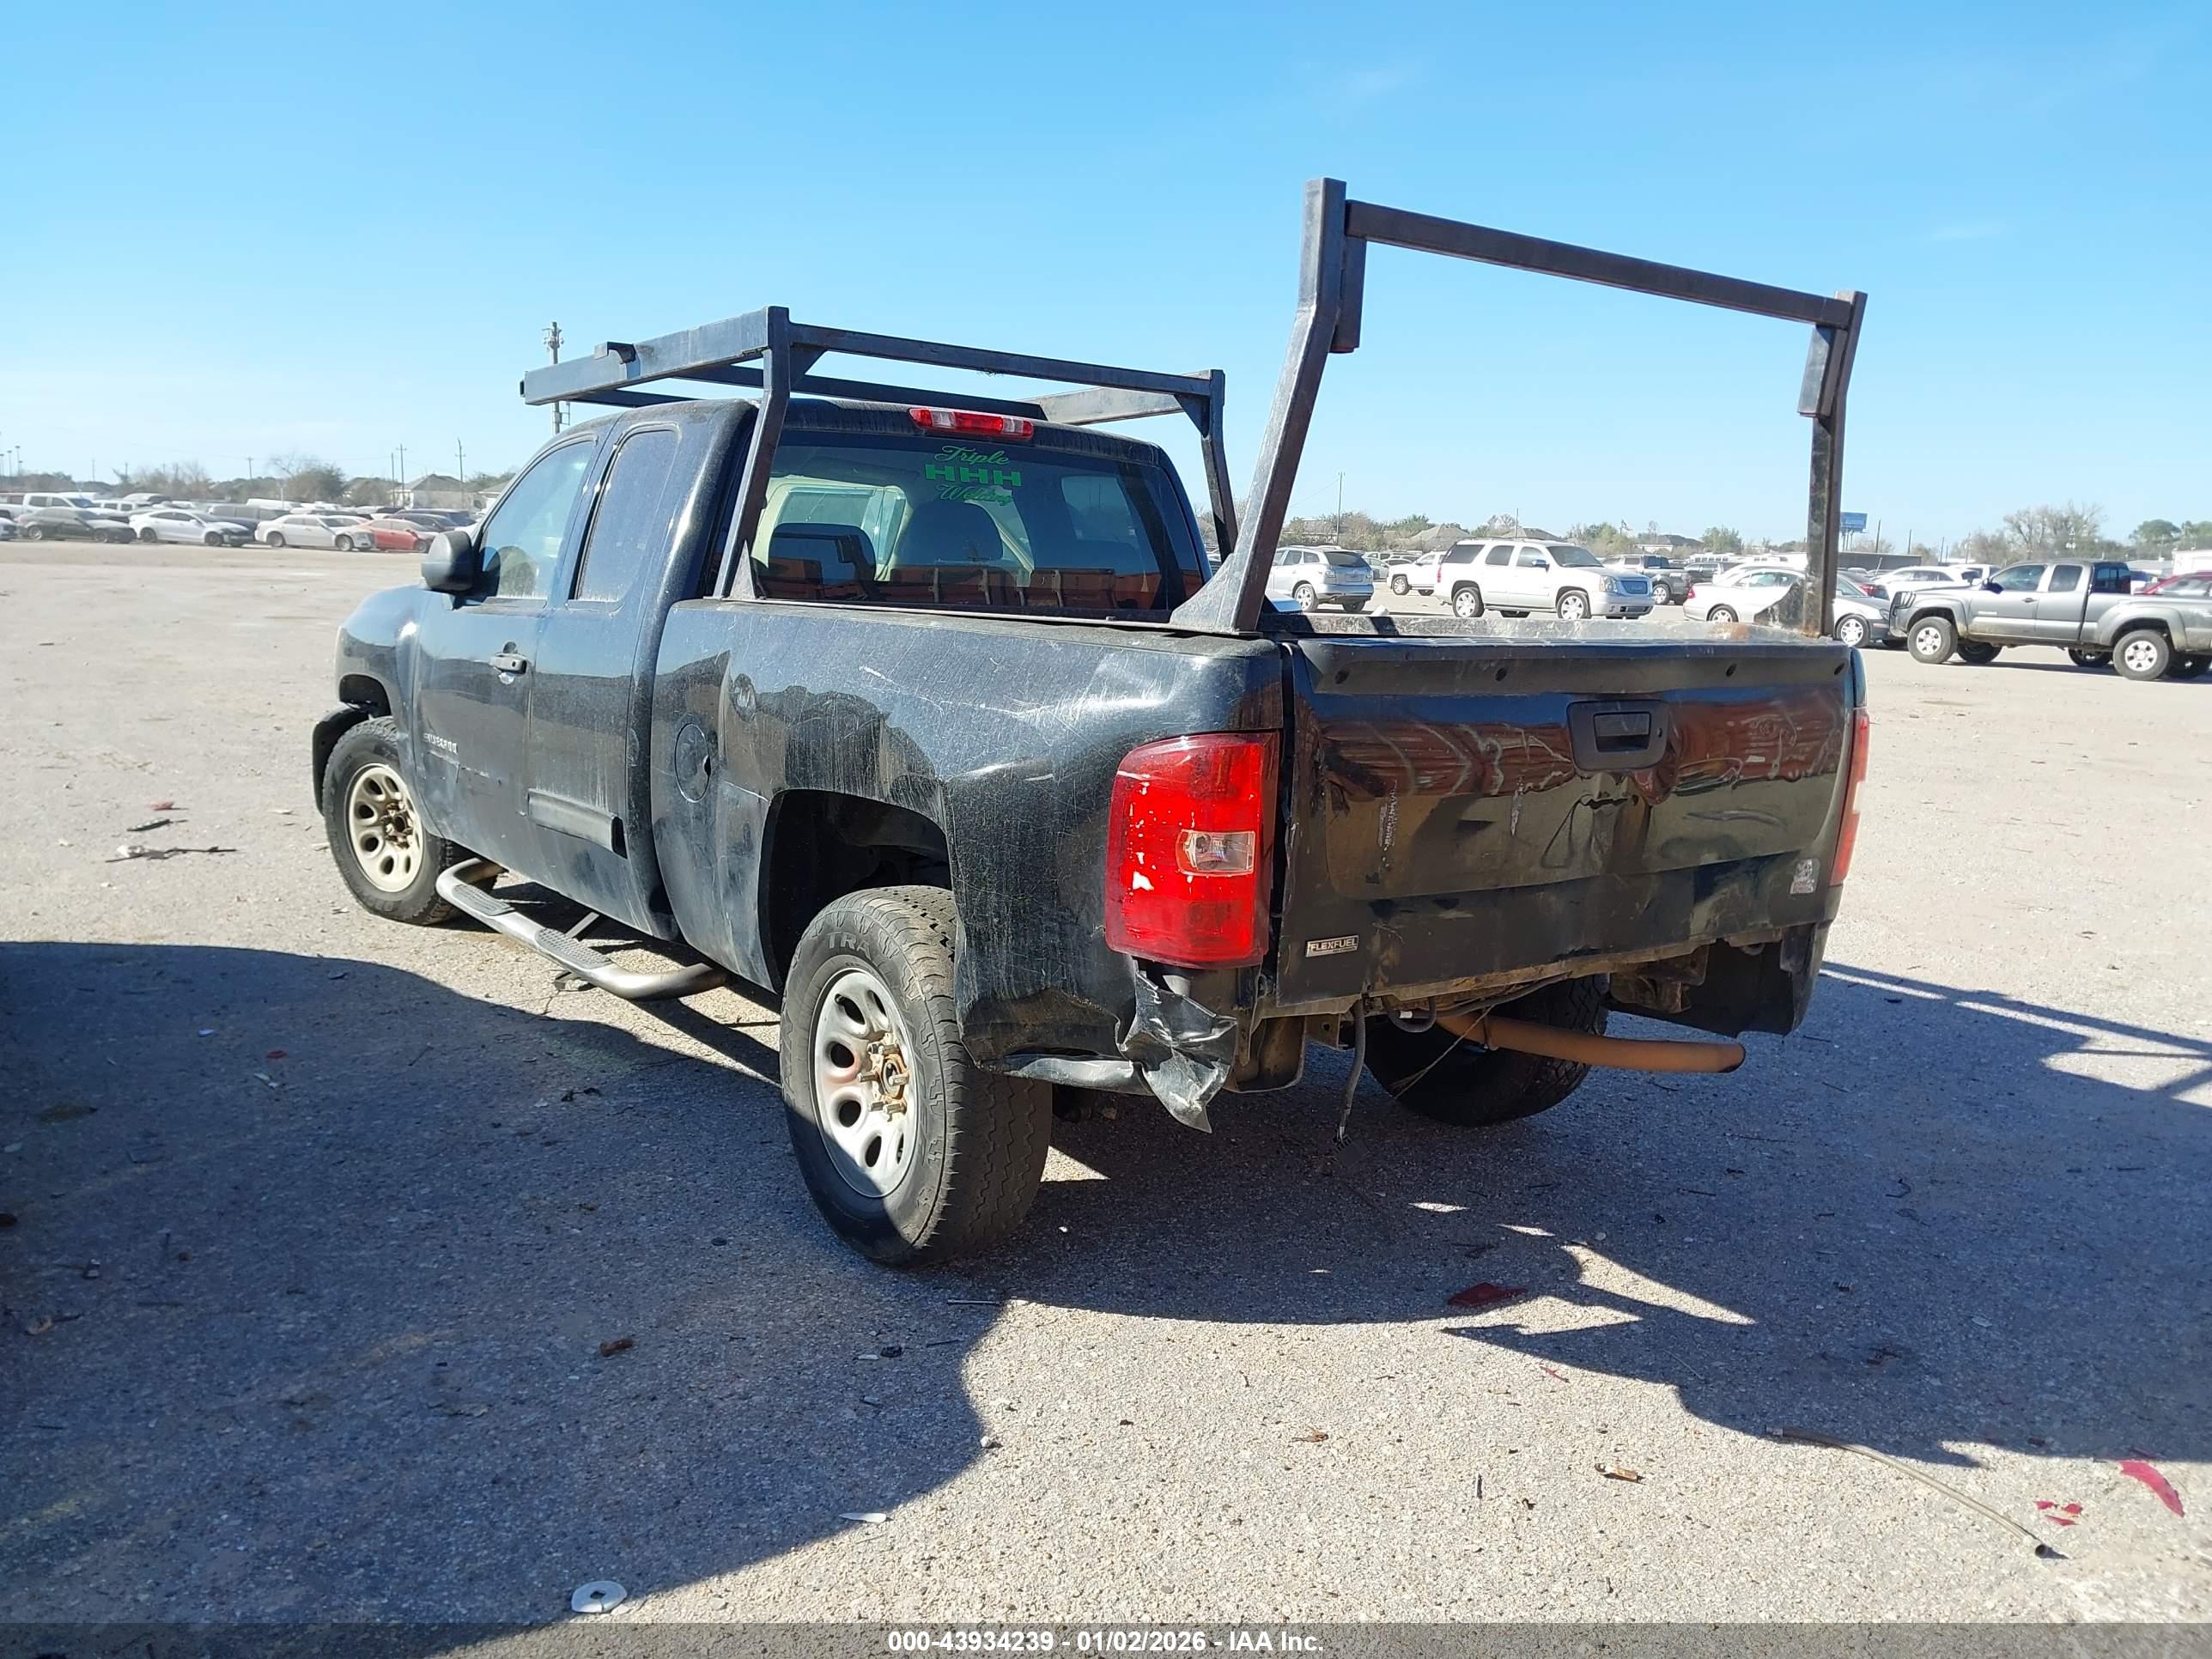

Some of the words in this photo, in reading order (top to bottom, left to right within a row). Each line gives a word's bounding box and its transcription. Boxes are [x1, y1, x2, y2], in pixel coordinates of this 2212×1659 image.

[933, 445, 1011, 466] Triple
[925, 464, 1023, 487] HHH
[936, 483, 1014, 507] Welding
[1310, 938, 1357, 952] FLEXFUEL
